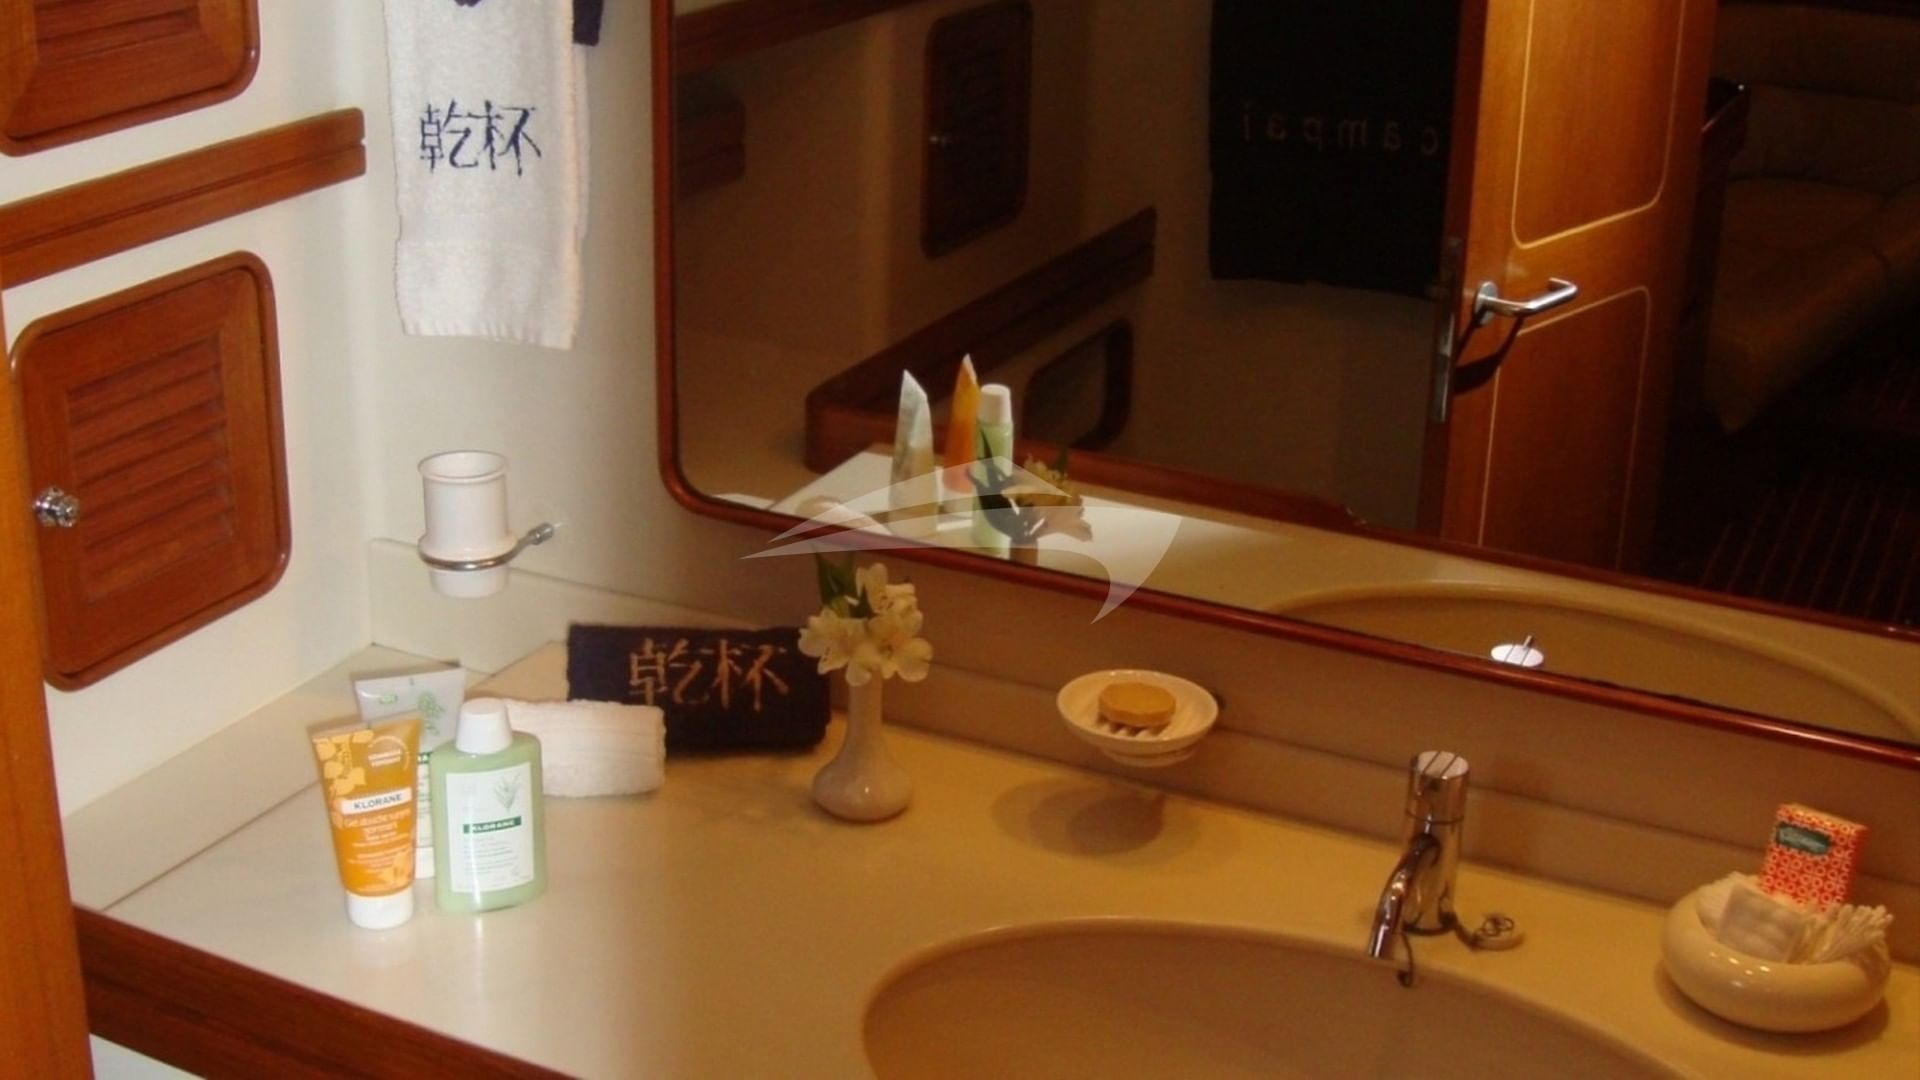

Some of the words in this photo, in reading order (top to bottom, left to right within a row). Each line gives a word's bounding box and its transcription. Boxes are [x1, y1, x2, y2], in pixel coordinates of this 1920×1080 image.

[420, 99, 542, 177] 乾杯
[629, 637, 789, 712] 乾杯
[353, 793, 402, 809] KLORANE
[469, 819, 515, 833] KLORANE
